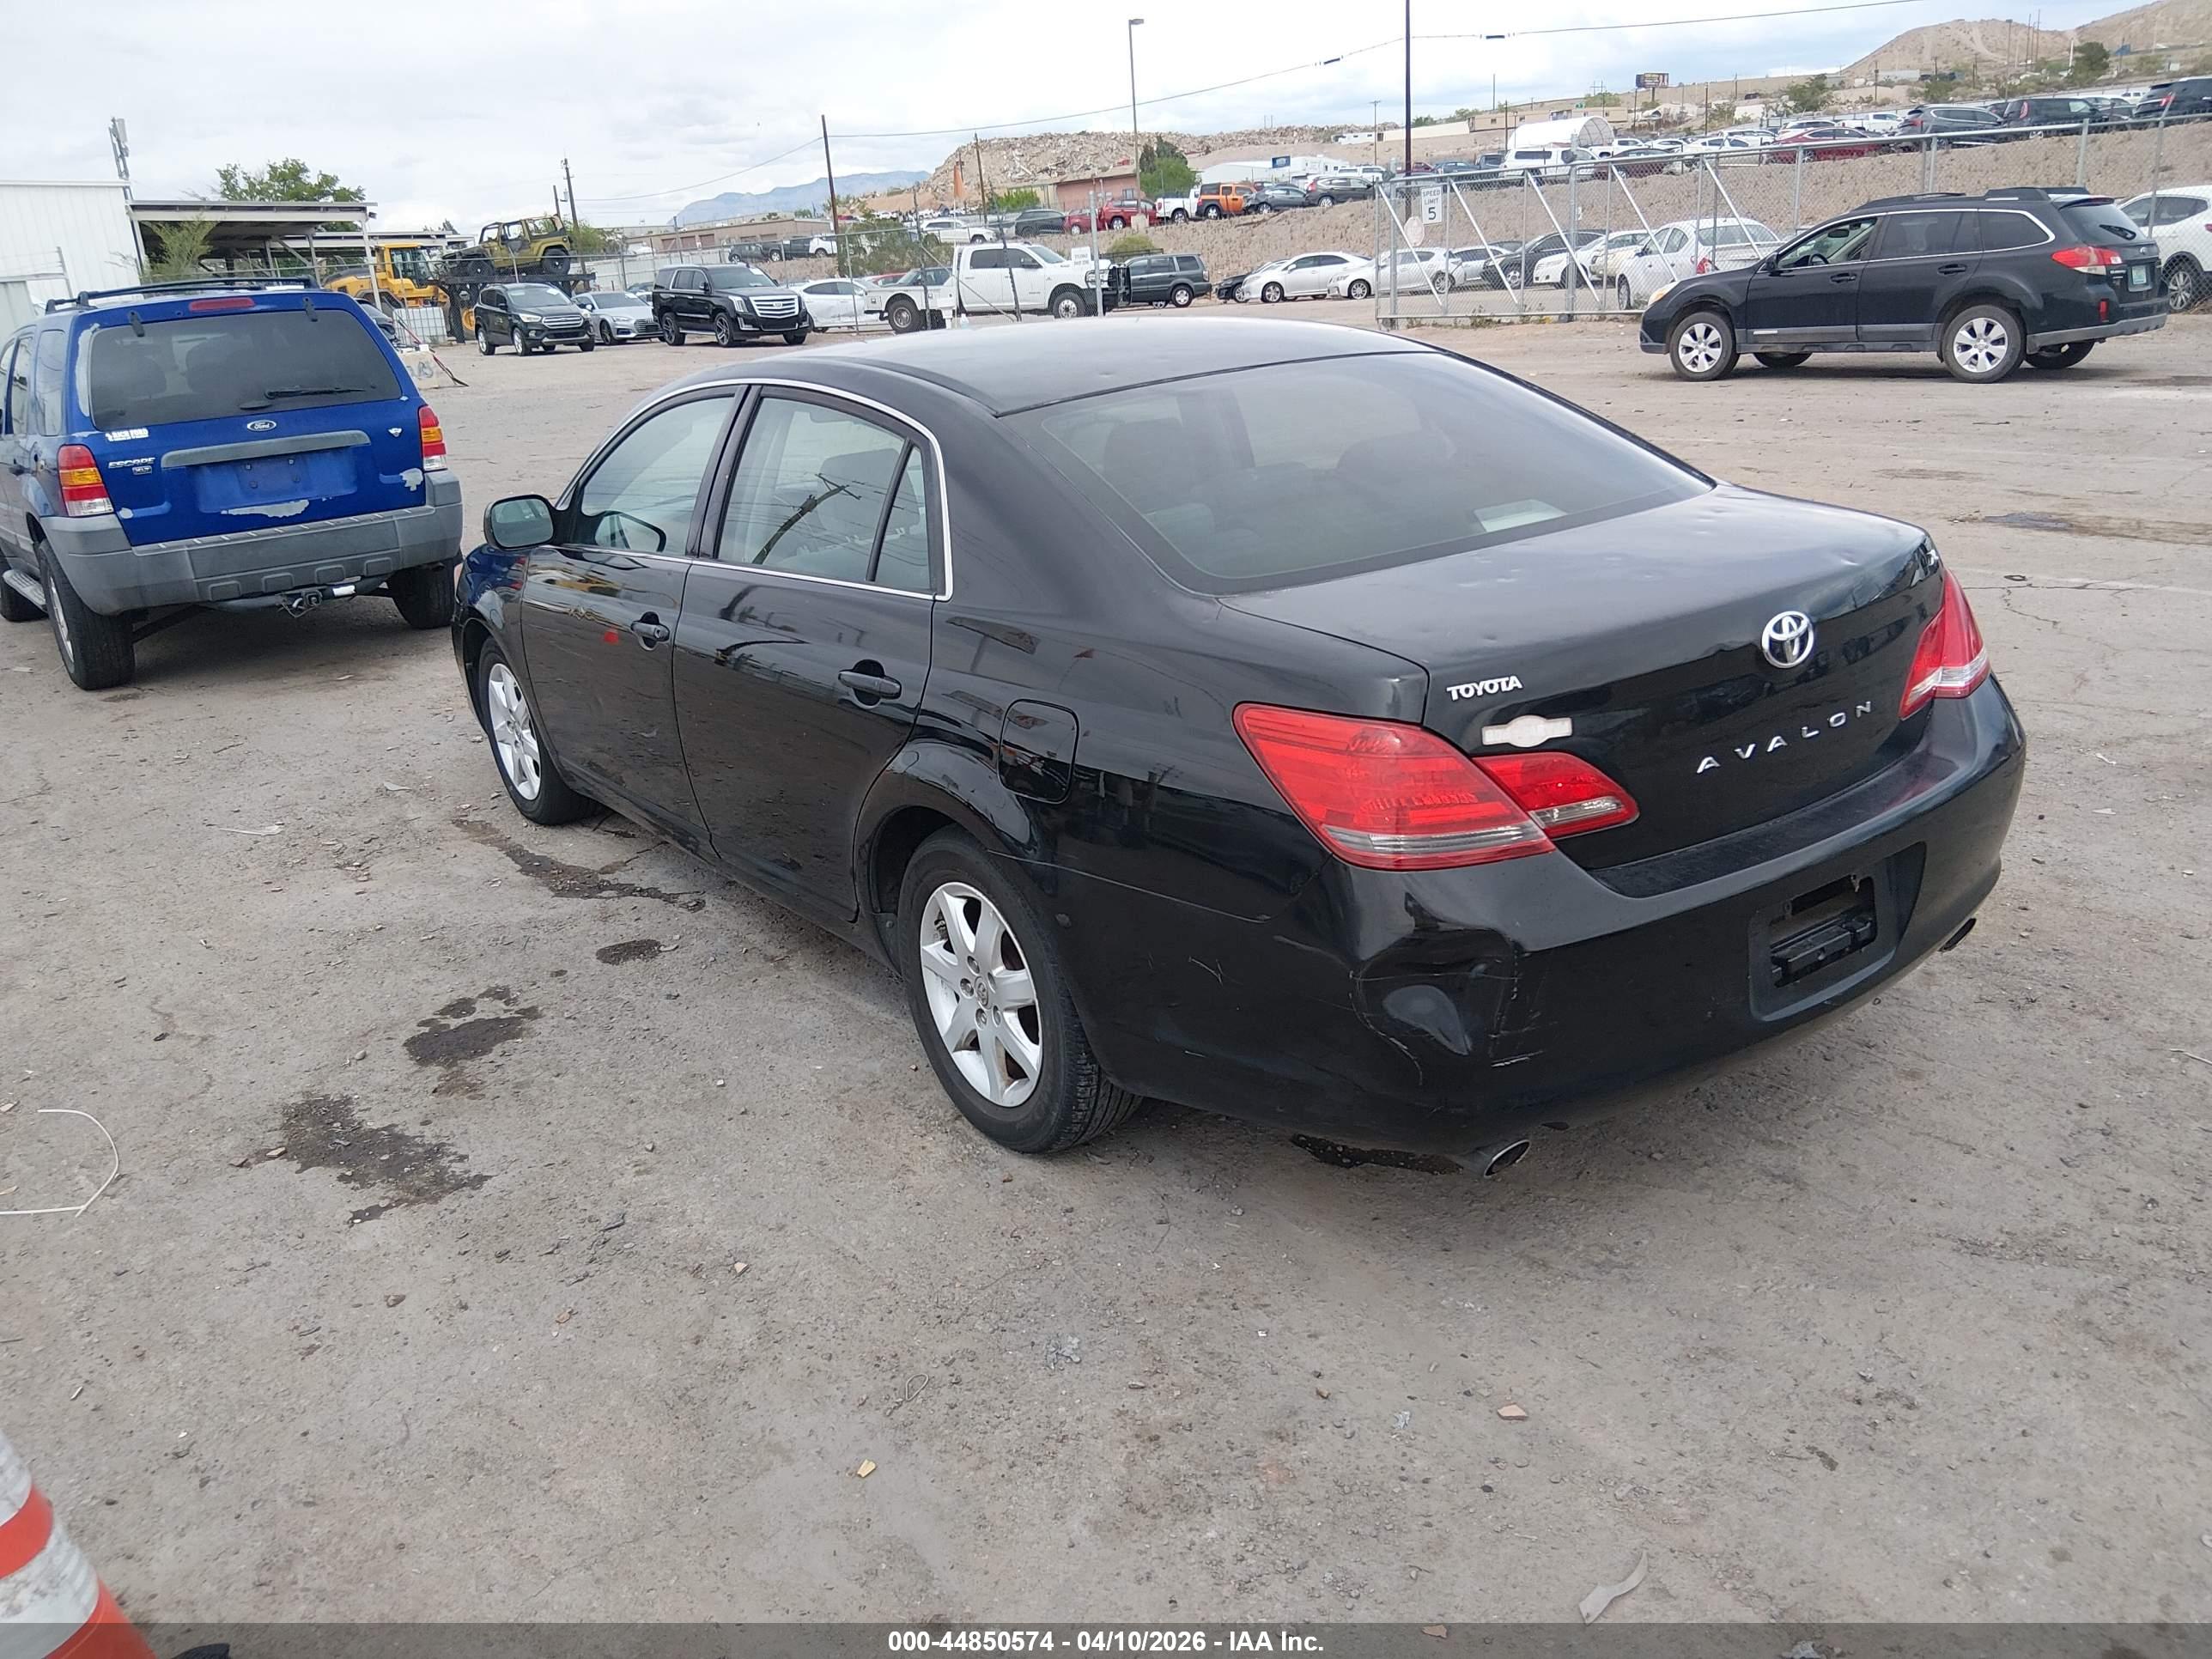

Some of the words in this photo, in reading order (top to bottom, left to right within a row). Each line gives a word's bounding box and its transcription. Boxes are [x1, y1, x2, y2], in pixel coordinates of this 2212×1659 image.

[1428, 206, 1437, 221] 5
[108, 457, 155, 469] ESCAPE
[1446, 675, 1523, 702] TOYOTA
[1696, 700, 1873, 775] AVALON
